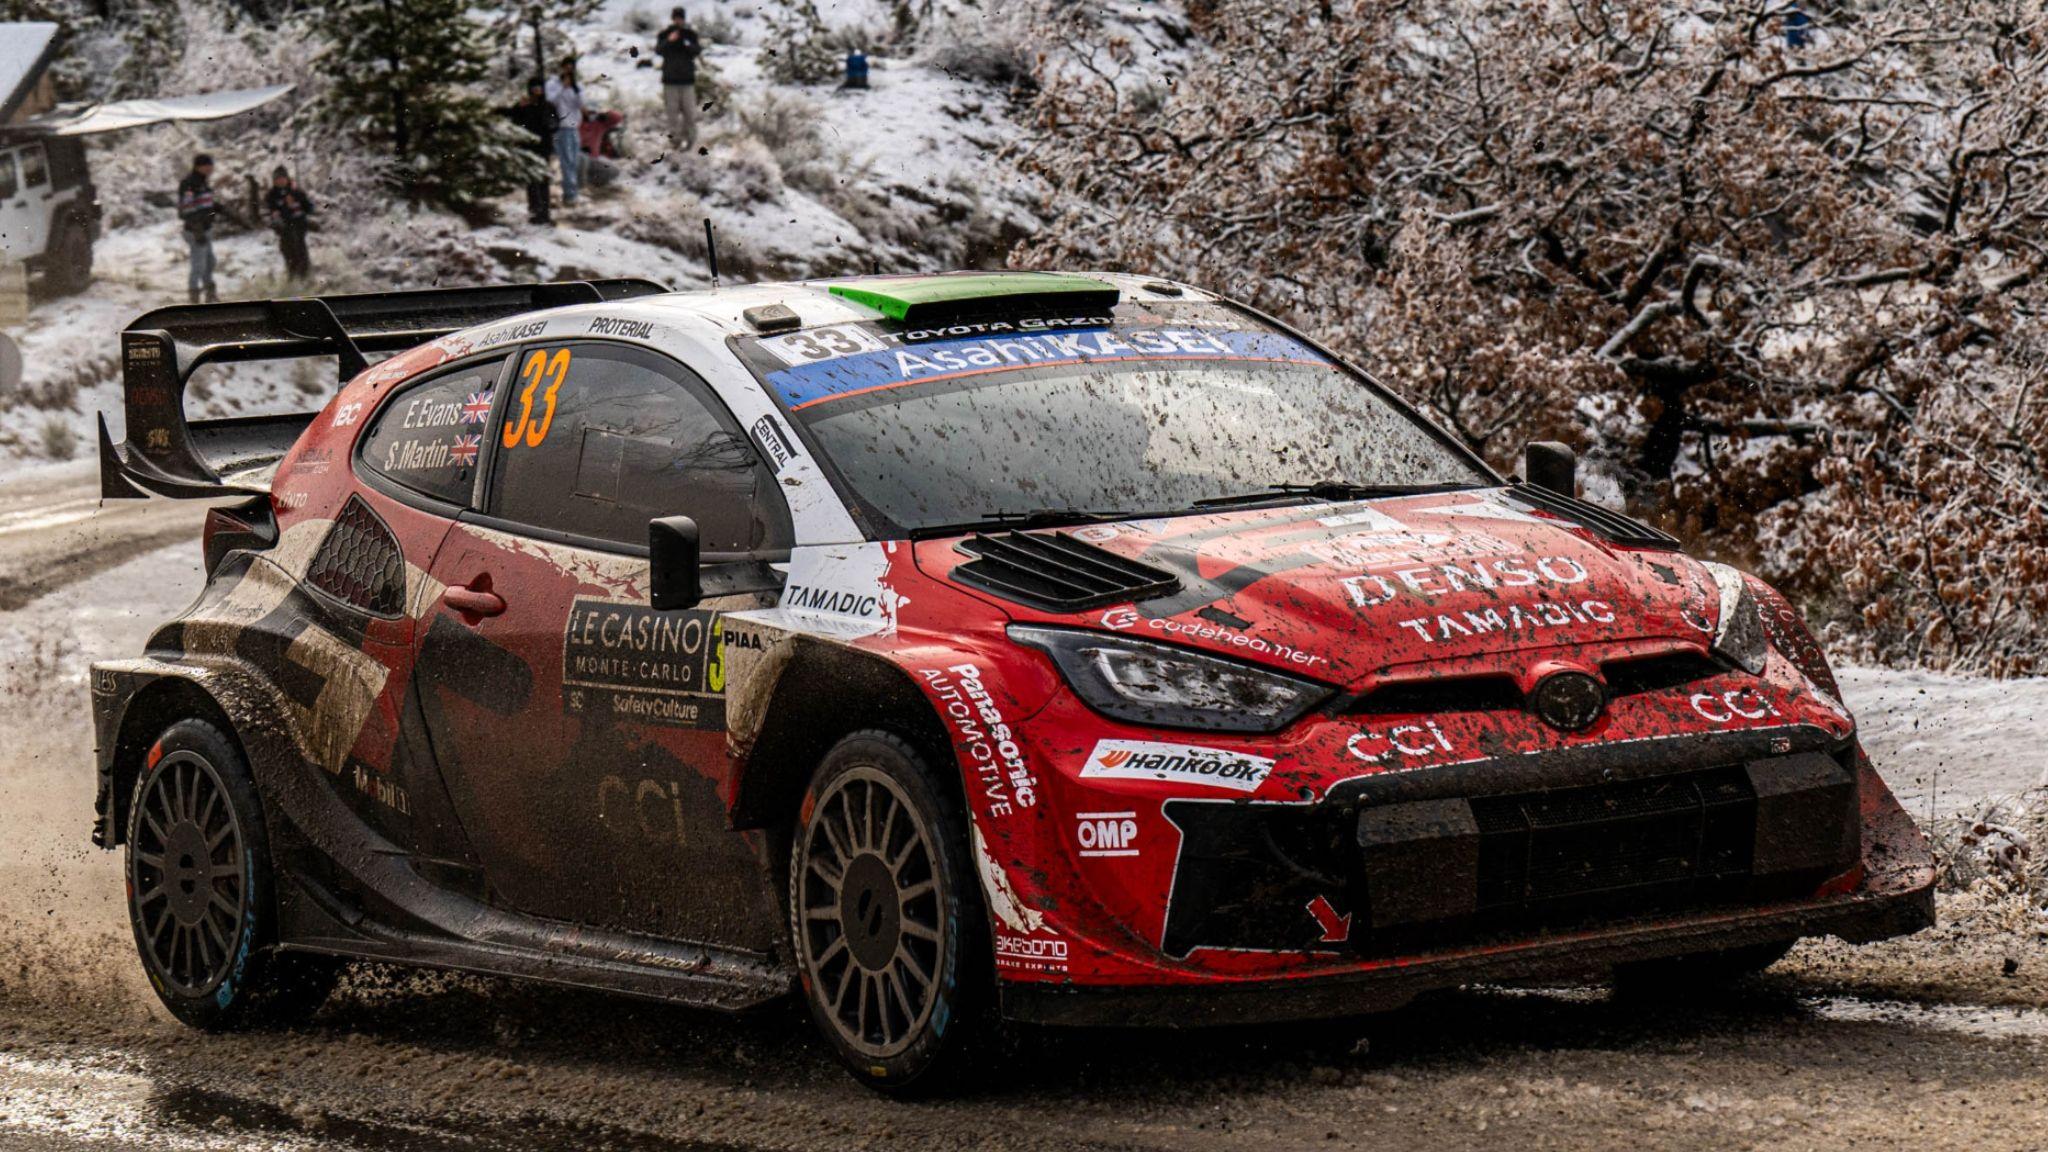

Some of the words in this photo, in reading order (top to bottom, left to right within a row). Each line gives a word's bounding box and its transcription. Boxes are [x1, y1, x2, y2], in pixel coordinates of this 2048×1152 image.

[588, 317, 655, 340] PROTERIAL
[785, 328, 862, 360] 33
[879, 320, 1014, 343] TOYOTA
[503, 348, 571, 449] 33
[754, 416, 788, 468] CENTRAL
[1340, 556, 1589, 607] DENSO
[787, 584, 876, 617] TAMADIC
[724, 629, 763, 650] PIAA
[1399, 600, 1615, 642] TAMADIC
[918, 668, 1013, 818] AUTOMOTIVE
[948, 663, 1037, 808] Panasonic
[1077, 820, 1138, 849] OMP
